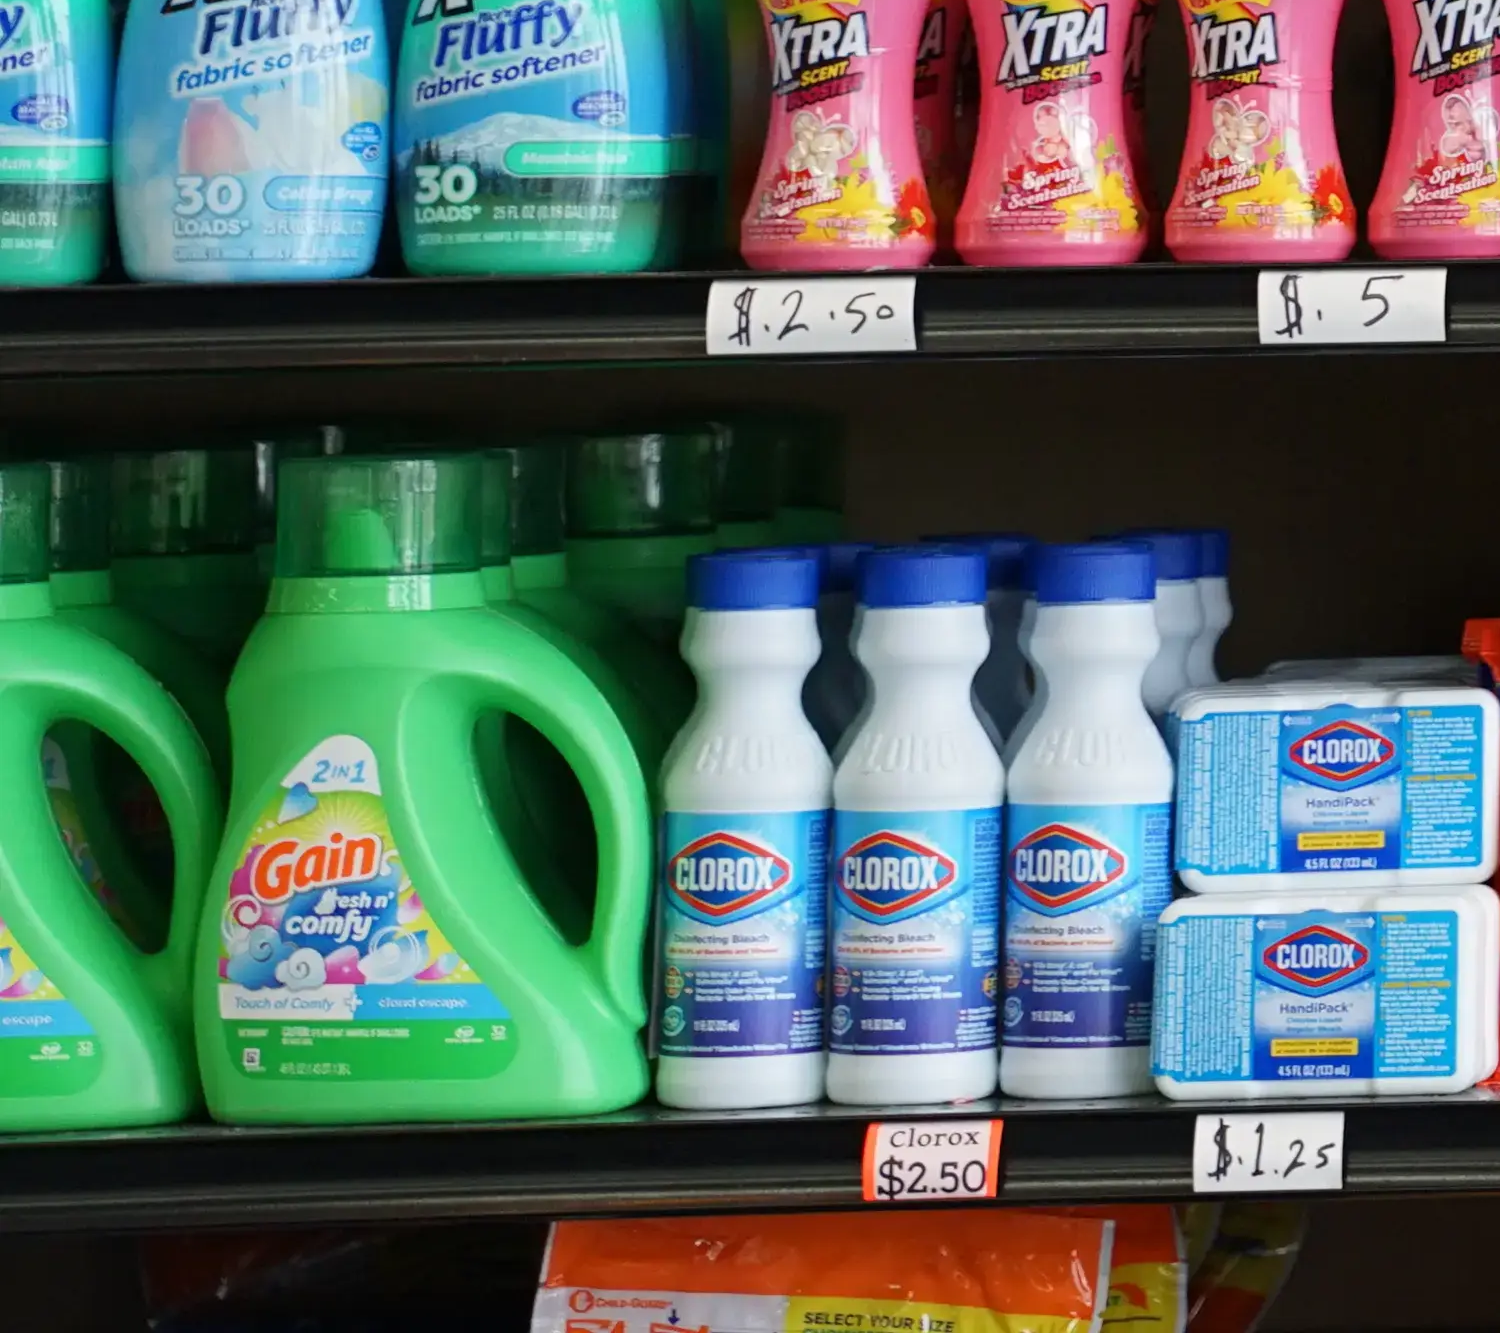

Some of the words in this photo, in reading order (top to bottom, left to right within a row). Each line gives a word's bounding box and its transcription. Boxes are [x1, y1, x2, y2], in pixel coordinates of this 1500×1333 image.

[998, 5, 1108, 83] XTRA
[415, 71, 487, 103] fabric
[489, 45, 606, 85] softener
[412, 164, 477, 204] 30
[1361, 275, 1403, 327] 5
[1303, 738, 1382, 764] CLOROX
[254, 833, 378, 902] Gain
[675, 855, 774, 892] CLOROX
[1015, 848, 1108, 884] CLOROX
[286, 907, 373, 943] comfy
[891, 1129, 980, 1150] Clorox
[877, 1155, 988, 1201] $2.50
[804, 1310, 864, 1330] SELECT
